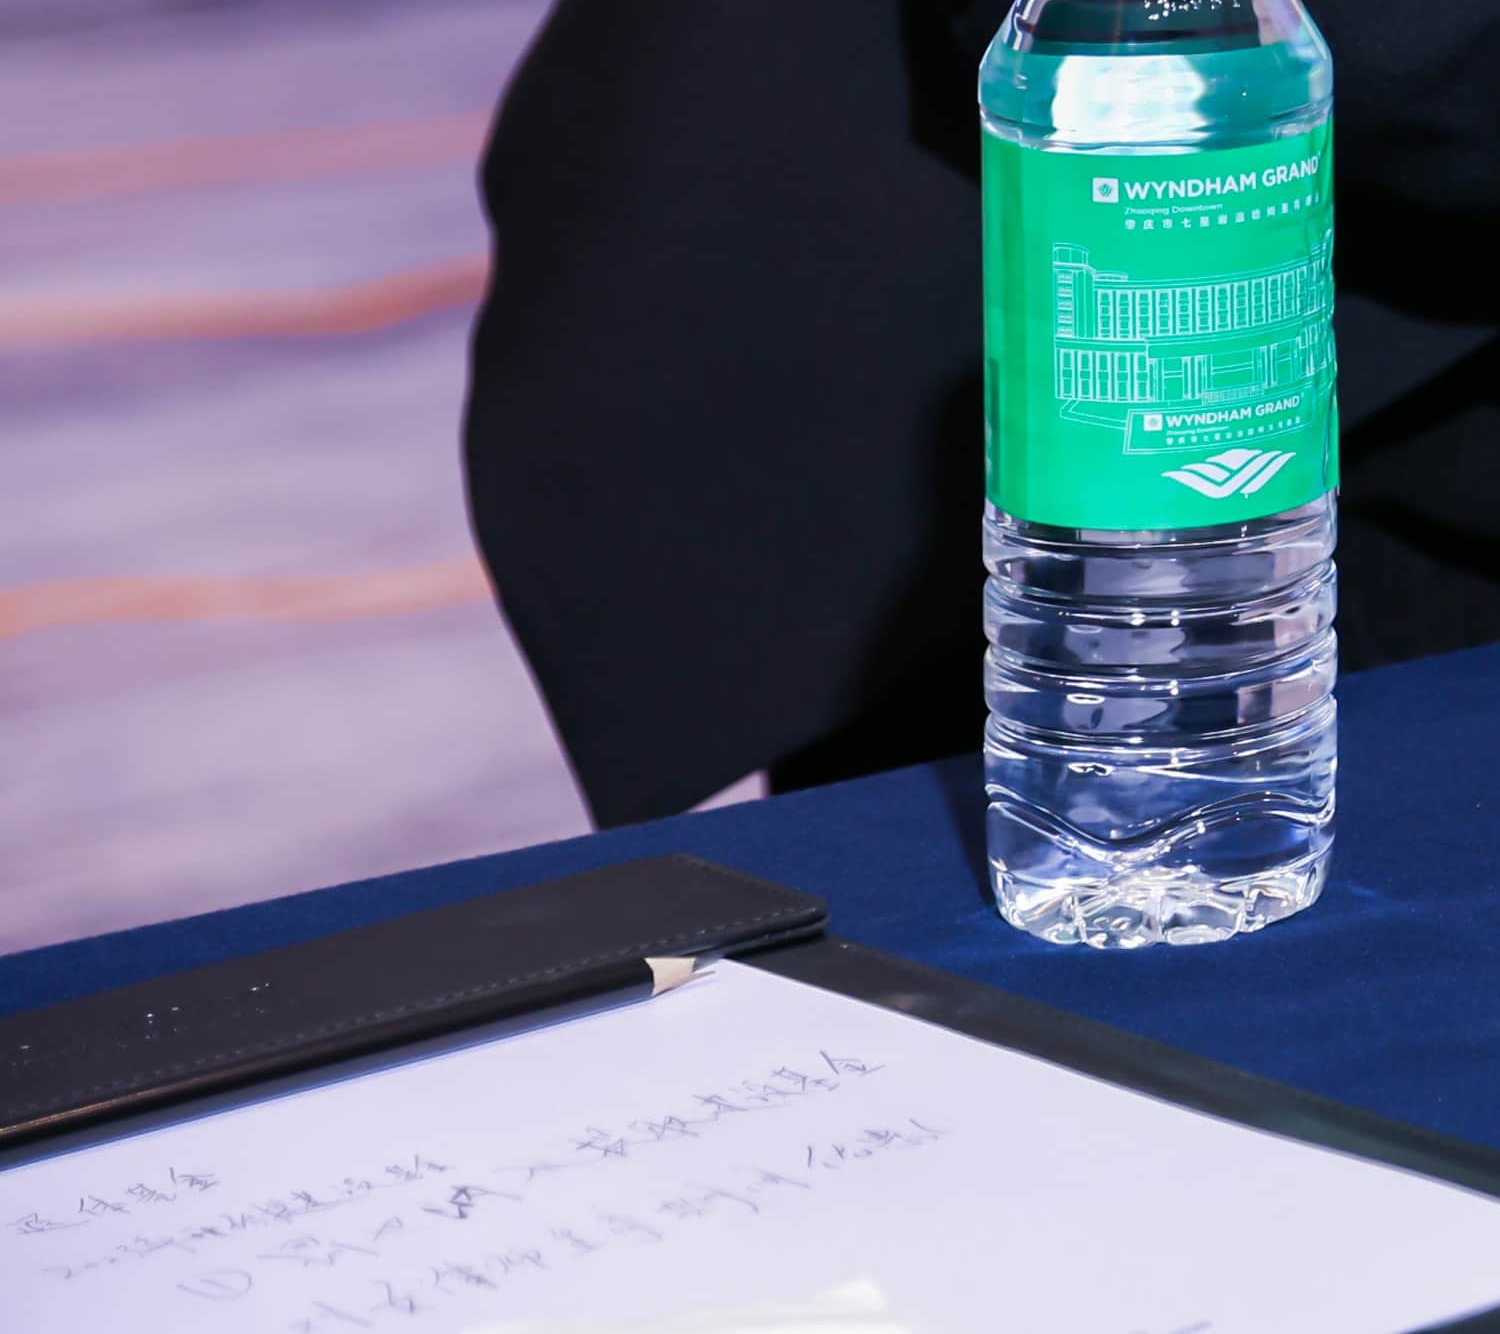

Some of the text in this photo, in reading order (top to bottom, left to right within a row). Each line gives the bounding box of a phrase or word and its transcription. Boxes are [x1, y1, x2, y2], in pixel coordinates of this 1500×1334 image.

[1124, 156, 1319, 200] WYNDHAM GRAND
[1166, 407, 1252, 428] WYNDHAM
[1255, 395, 1300, 416] GRAND
